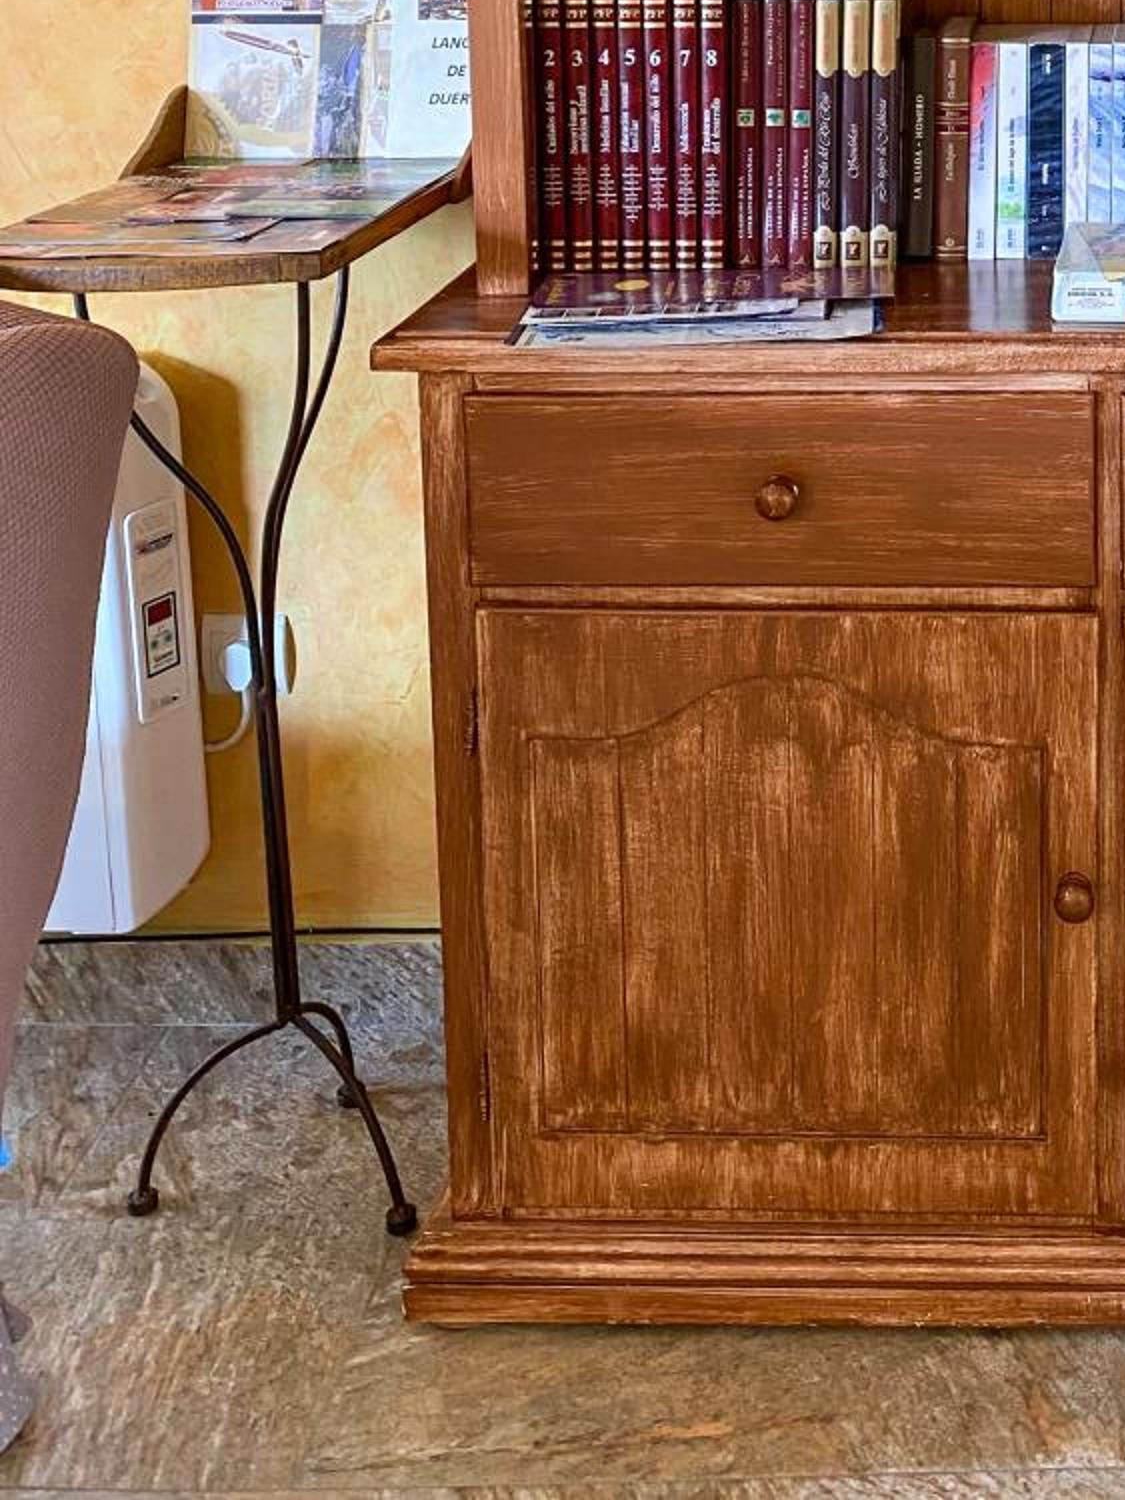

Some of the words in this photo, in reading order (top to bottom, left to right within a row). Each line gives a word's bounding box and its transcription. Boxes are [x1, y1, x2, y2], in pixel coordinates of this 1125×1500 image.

[544, 49, 555, 66] 2
[571, 49, 583, 66] 3
[598, 49, 610, 66] 4
[623, 49, 636, 66] 5
[650, 49, 661, 66] 6
[679, 49, 691, 66] 7
[705, 49, 717, 66] 8
[447, 64, 466, 77] DE
[914, 94, 924, 140] HOMERO
[913, 150, 923, 183] ILIADA
[913, 187, 922, 201] LA
